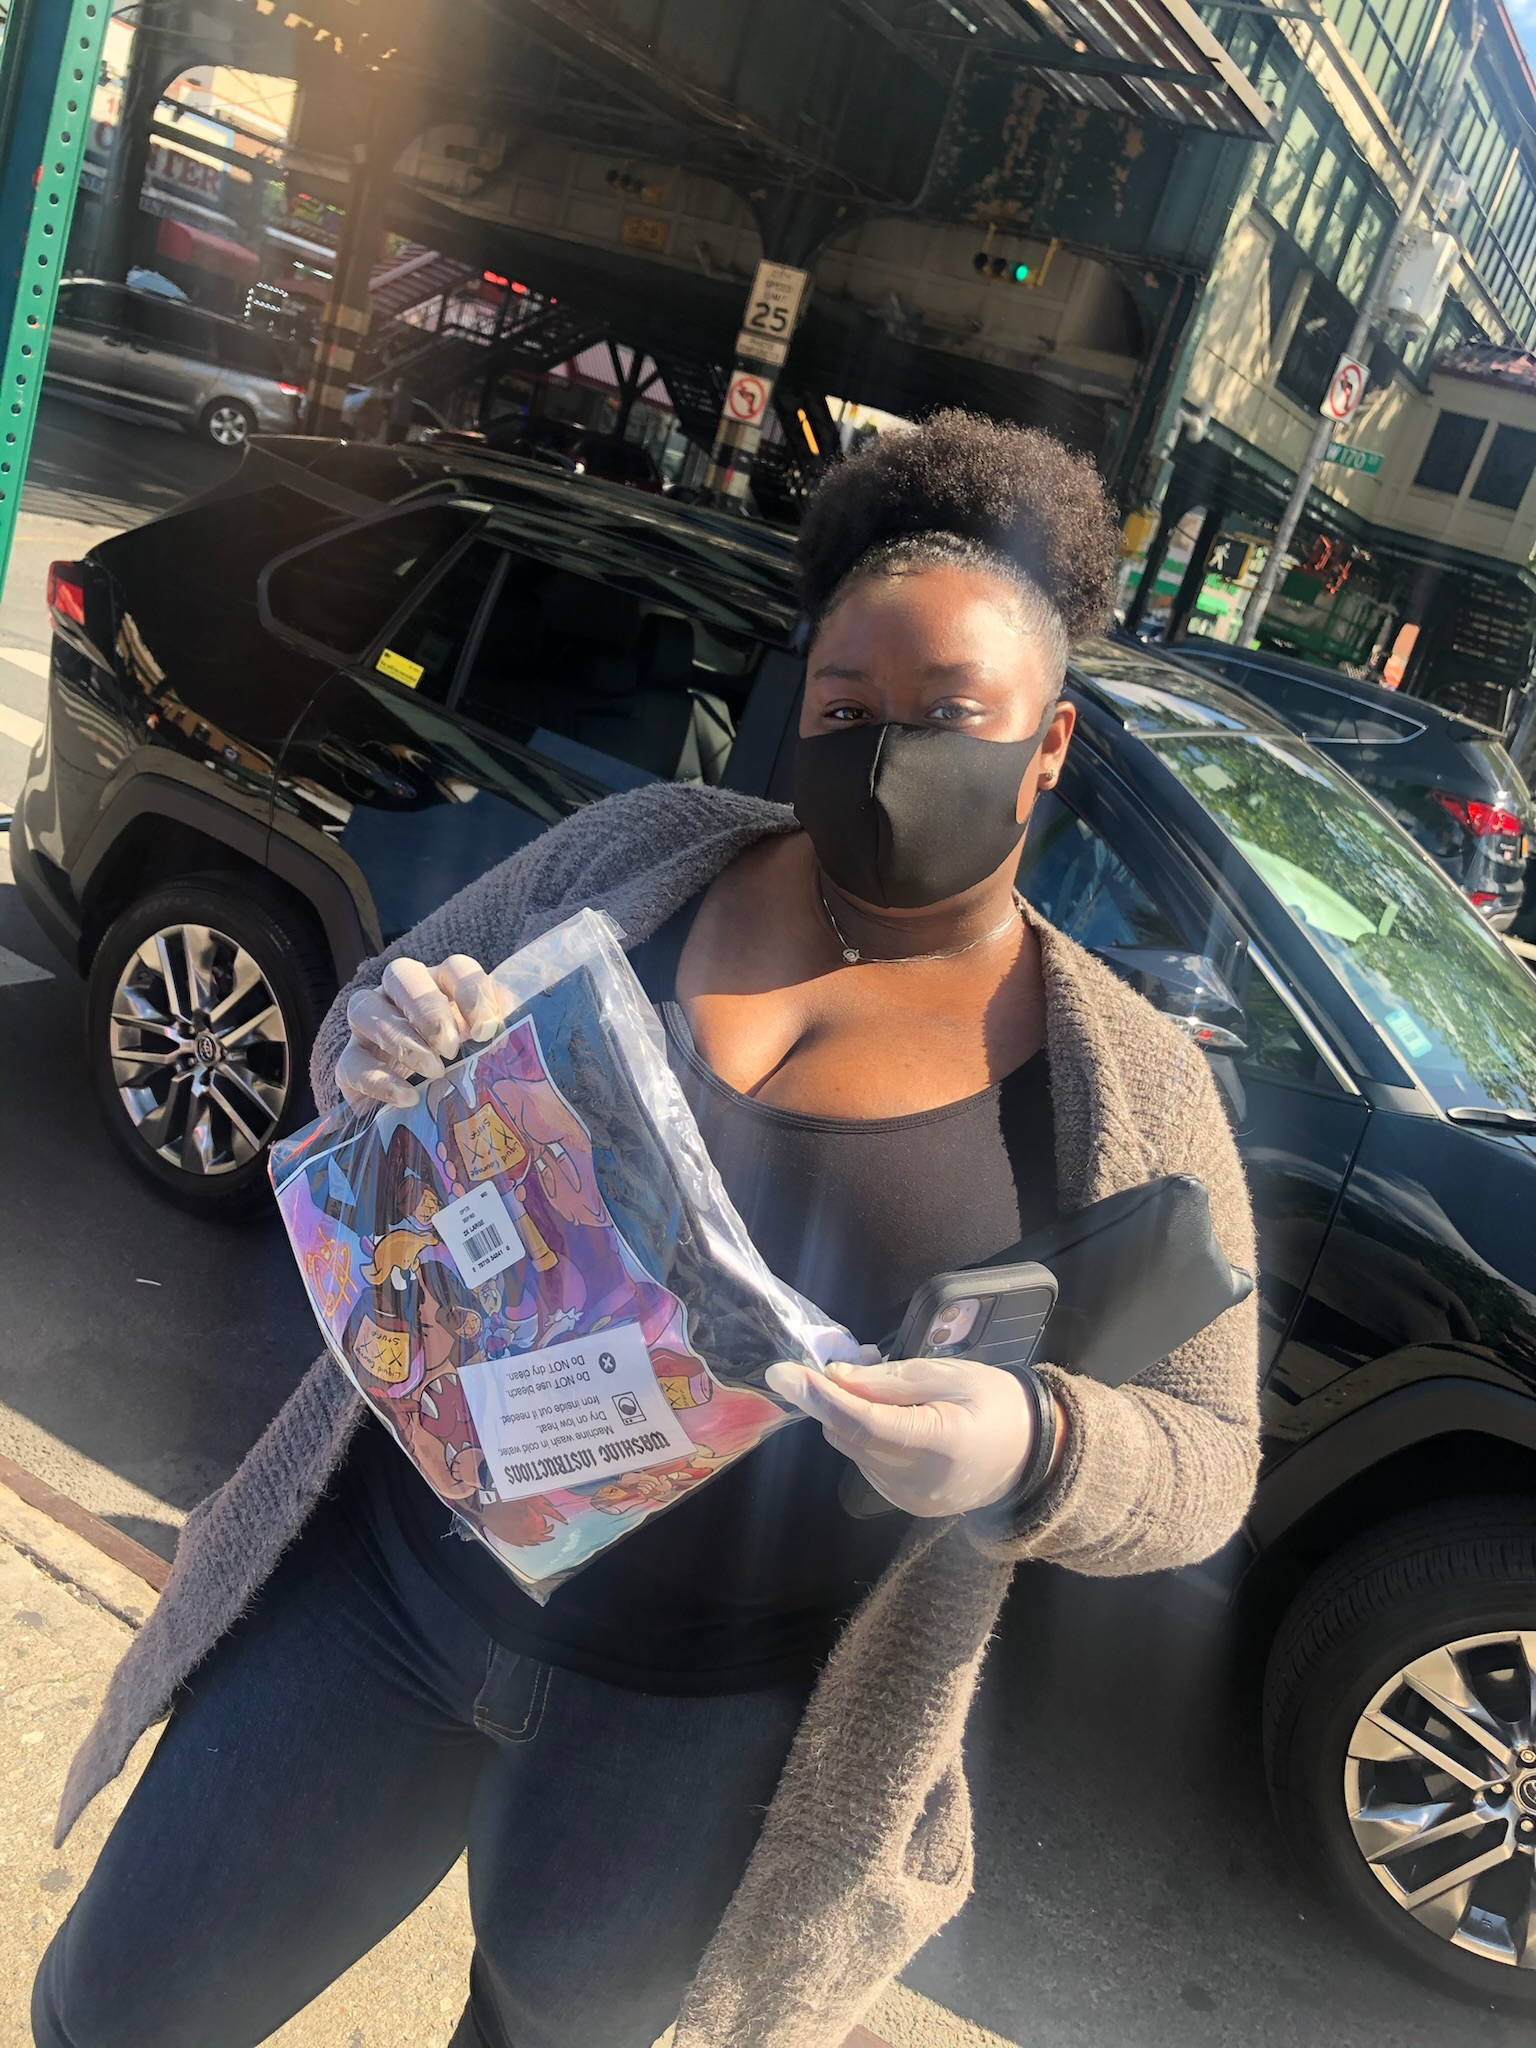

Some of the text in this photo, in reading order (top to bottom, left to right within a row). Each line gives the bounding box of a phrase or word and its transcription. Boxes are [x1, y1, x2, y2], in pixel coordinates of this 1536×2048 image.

[751, 302, 789, 332] 25
[1326, 442, 1342, 462] W
[1340, 448, 1367, 469] 170
[501, 1141, 522, 1165] Liquid
[469, 1219, 485, 1234] LARGE
[506, 1354, 586, 1381] Do NOT dry clean.
[505, 1370, 591, 1399] Do NOT use bleach.
[499, 1395, 601, 1426] Iron inside out if needed.
[535, 1410, 607, 1435] Dry on low heat.
[497, 1424, 615, 1457] Machine wash in cold water.
